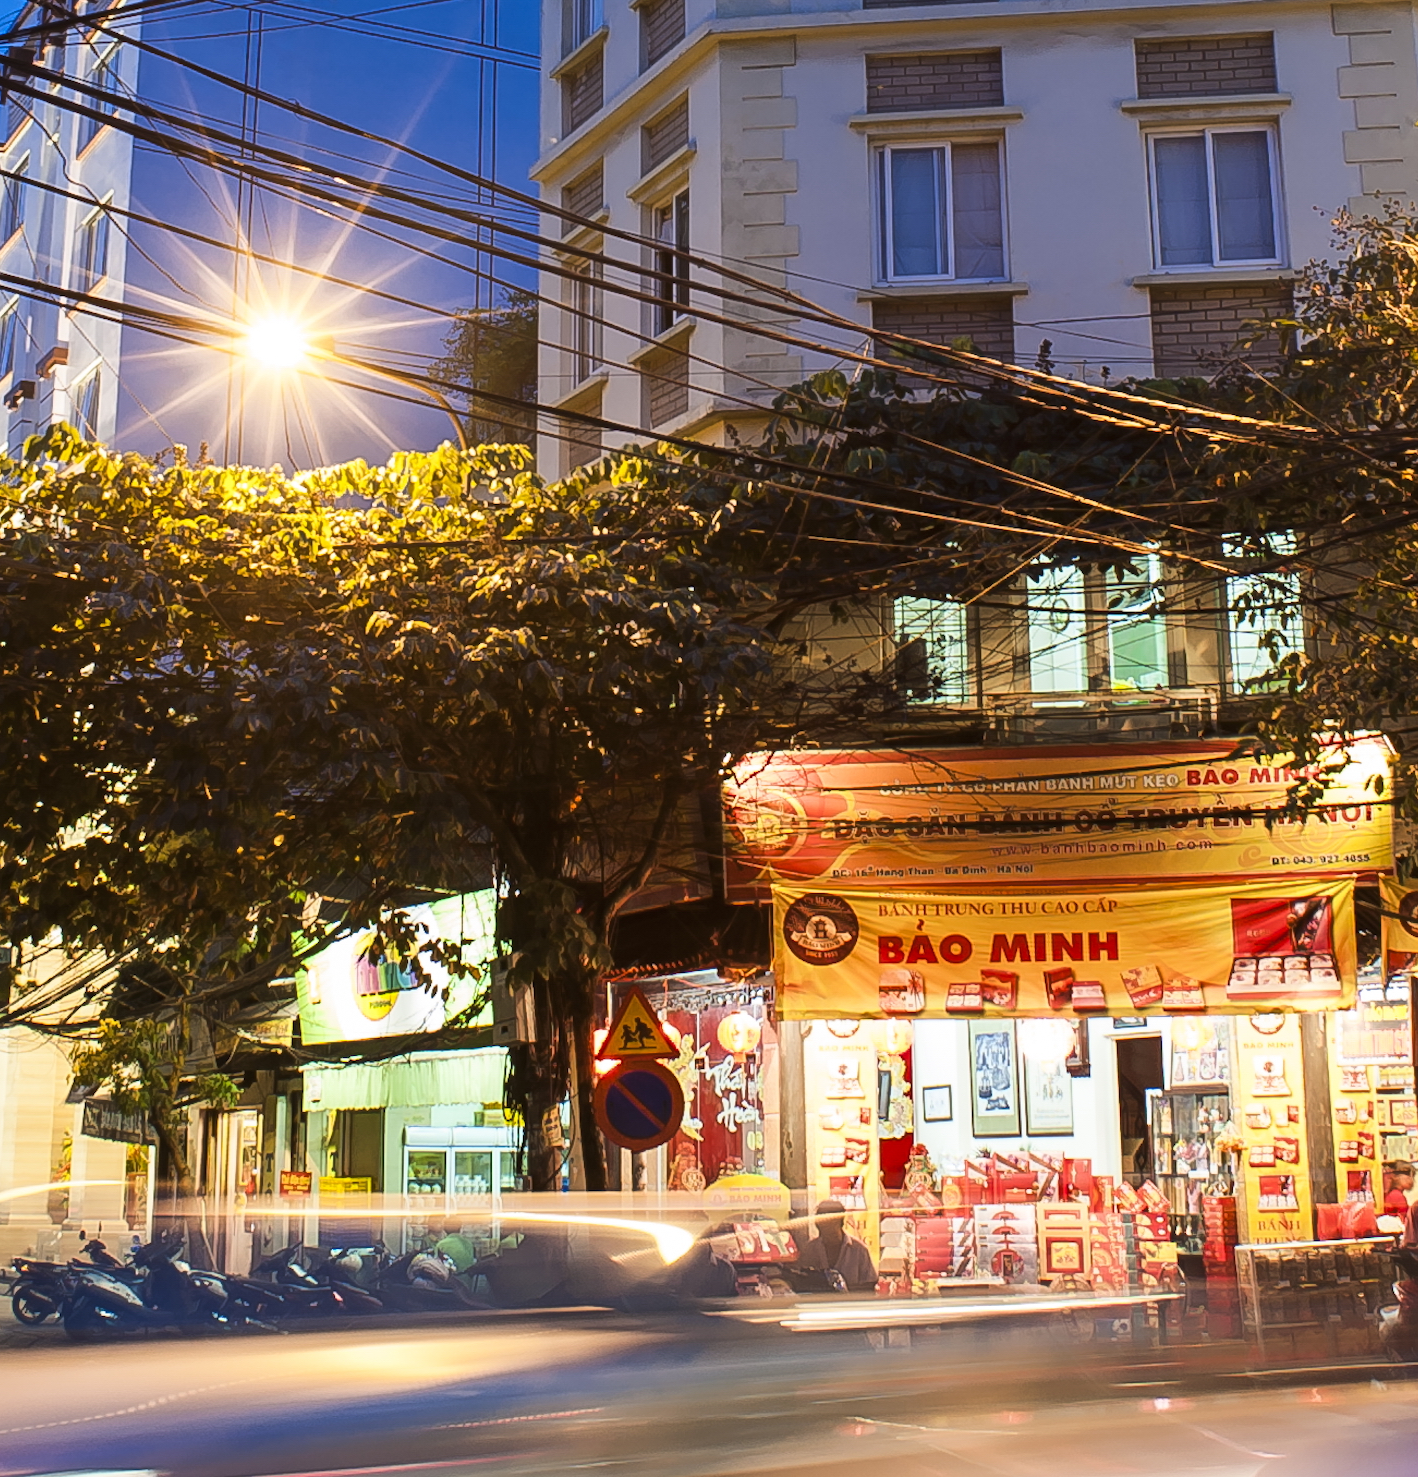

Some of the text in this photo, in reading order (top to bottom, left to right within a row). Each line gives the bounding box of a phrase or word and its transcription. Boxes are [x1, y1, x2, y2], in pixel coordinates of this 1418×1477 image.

[878, 896, 1118, 917] BÁNH TRUNG THU CAO CẤP
[877, 919, 1120, 964] BẢO MINH
